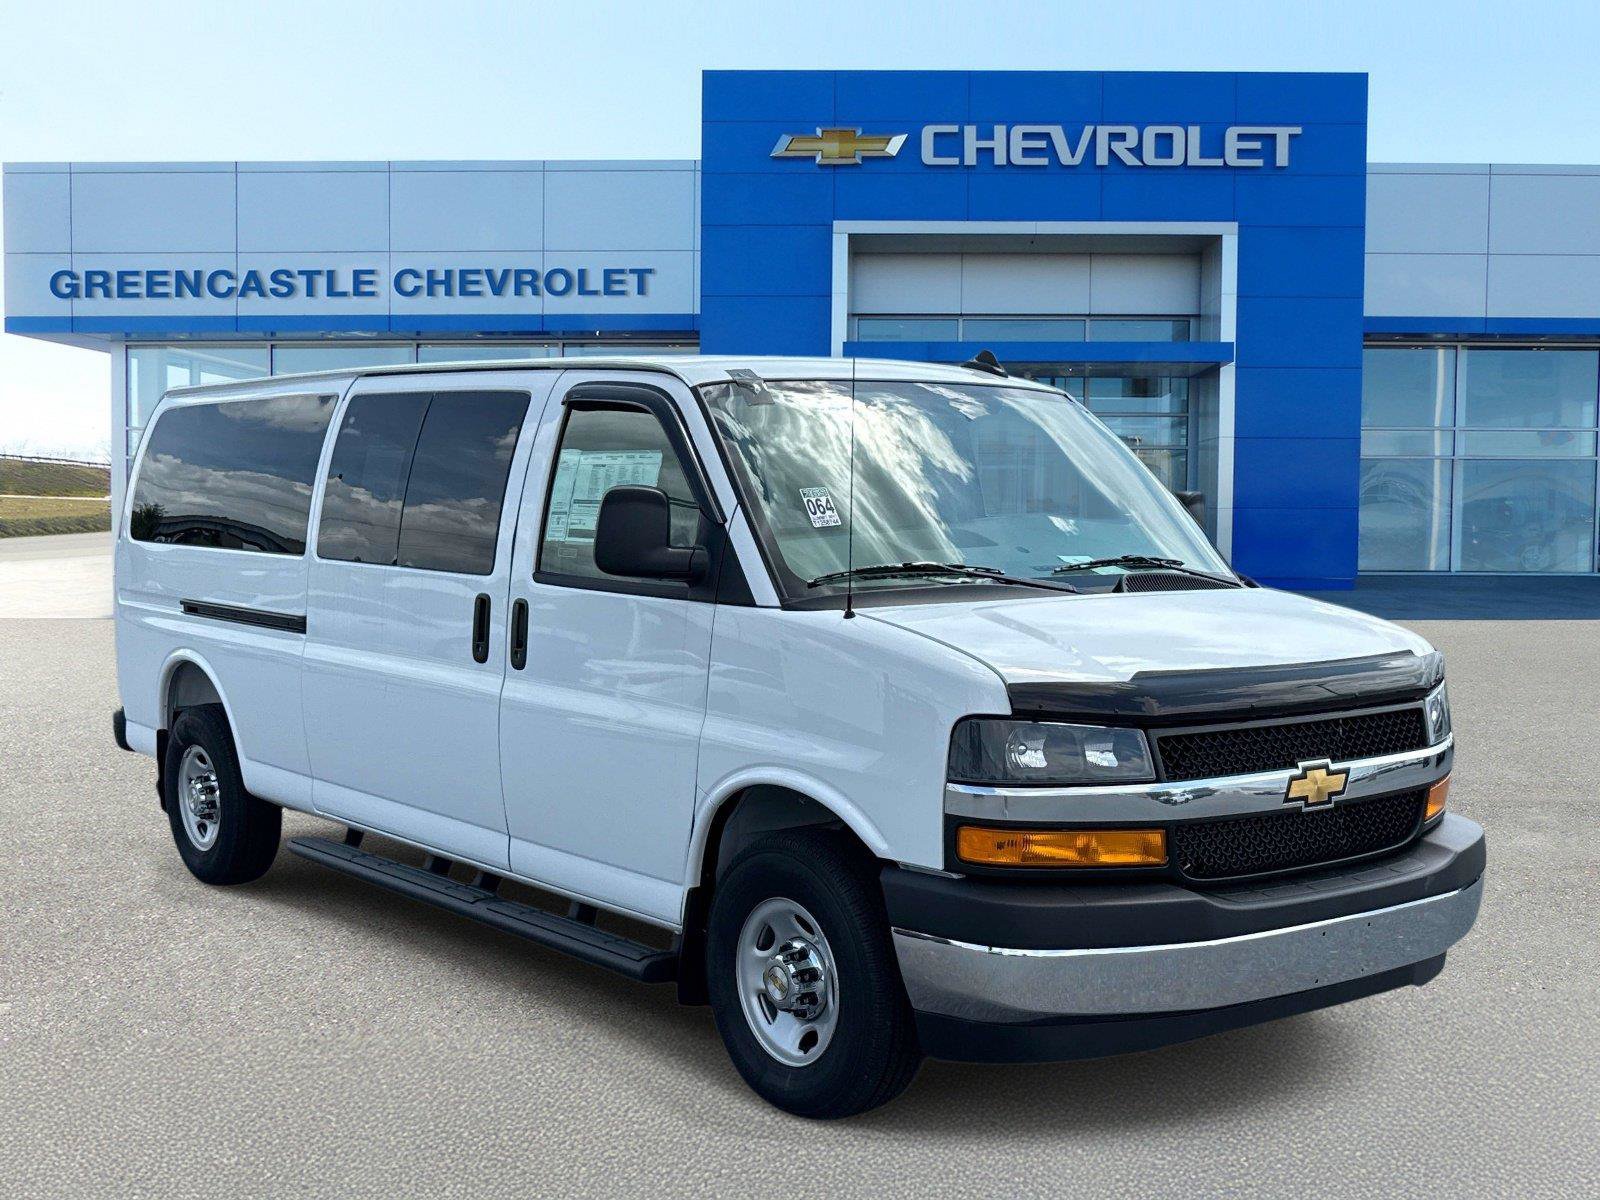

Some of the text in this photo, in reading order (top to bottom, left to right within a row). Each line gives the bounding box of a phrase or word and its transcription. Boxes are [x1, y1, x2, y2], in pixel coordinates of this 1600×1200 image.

[921, 125, 1302, 168] CHEVROLET
[50, 268, 654, 299] GREENCASTLE CHEVROLET
[806, 498, 835, 516] 064
